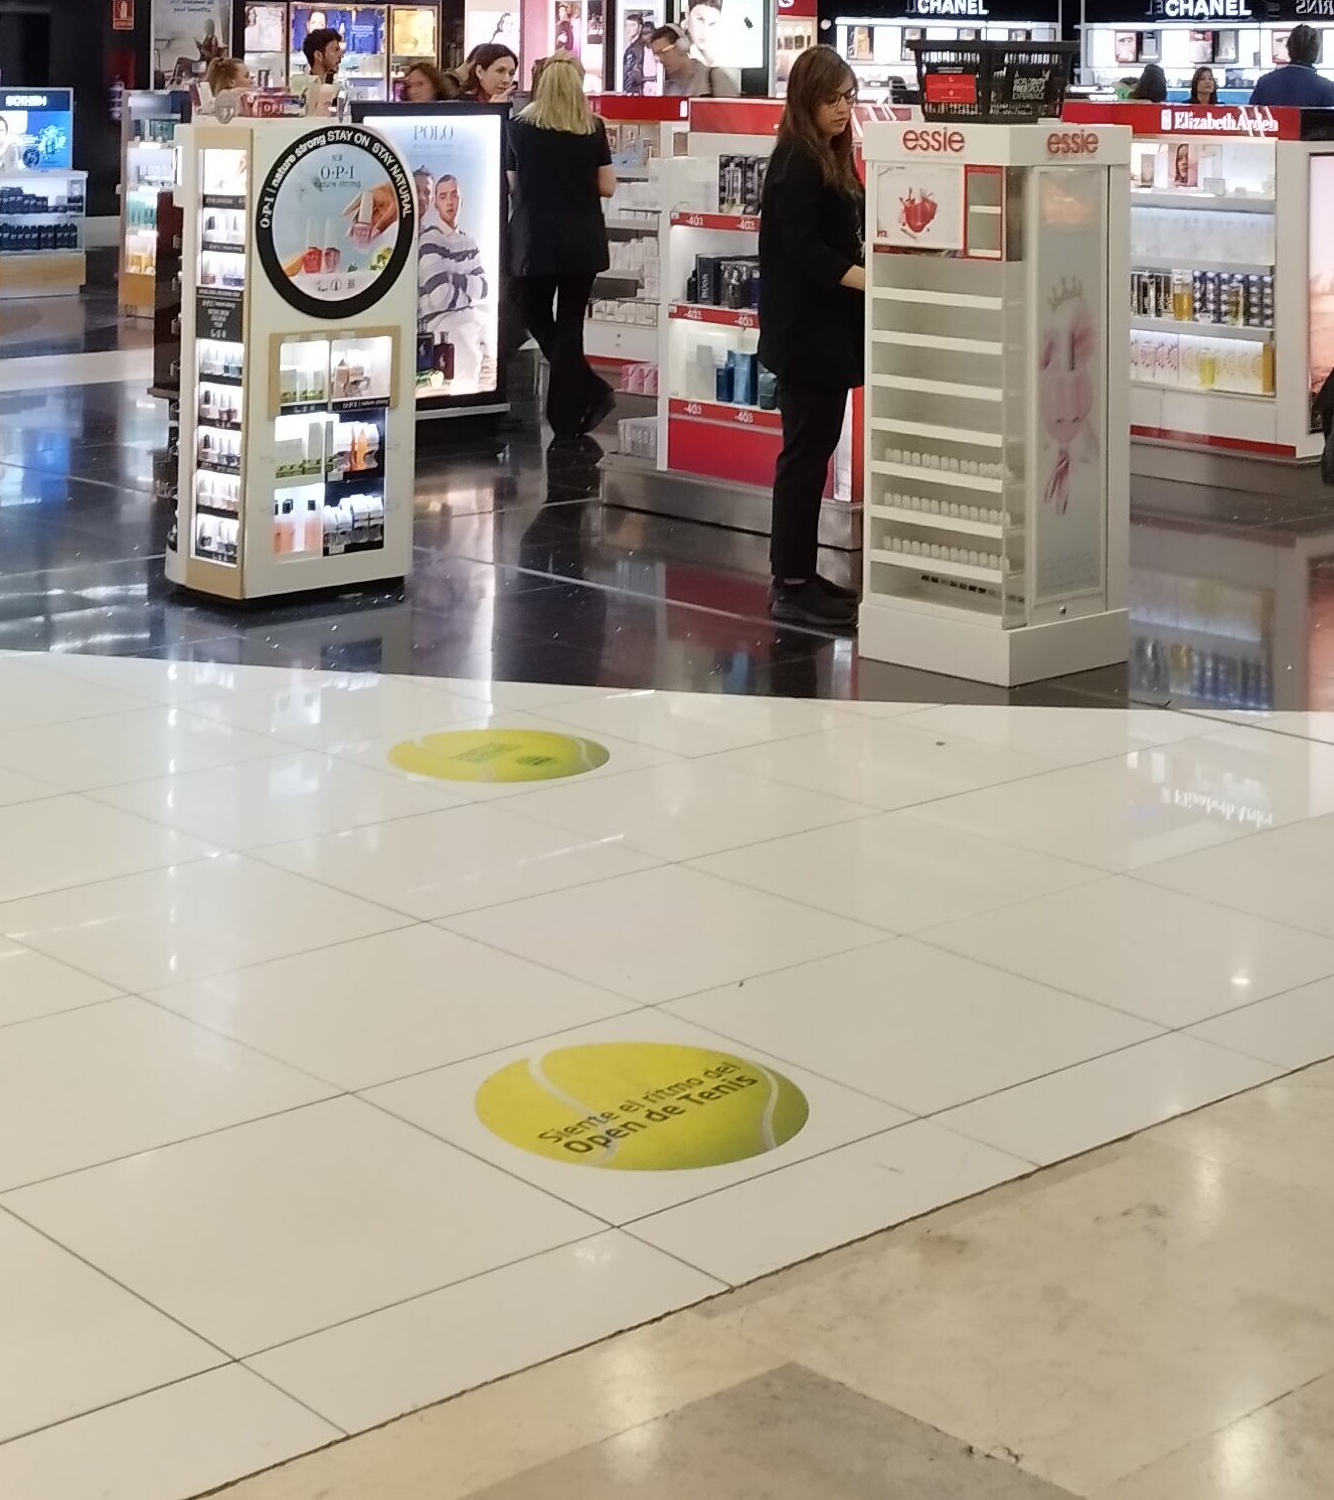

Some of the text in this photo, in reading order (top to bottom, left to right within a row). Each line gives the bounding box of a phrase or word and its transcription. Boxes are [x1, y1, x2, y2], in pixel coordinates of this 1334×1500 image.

[413, 124, 454, 140] POLO
[1174, 110, 1279, 133] Elizabeth Arden
[903, 127, 966, 153] essie
[1047, 129, 1100, 155] essie
[272, 154, 297, 188] nature
[295, 133, 327, 156] strong
[327, 129, 354, 142] STAY
[354, 132, 371, 147] ON
[372, 142, 396, 166] STAY
[389, 163, 412, 219] NATURAL
[539, 1061, 742, 1143] Siente el ritmo del
[564, 1075, 759, 1154] Open de Tenis
